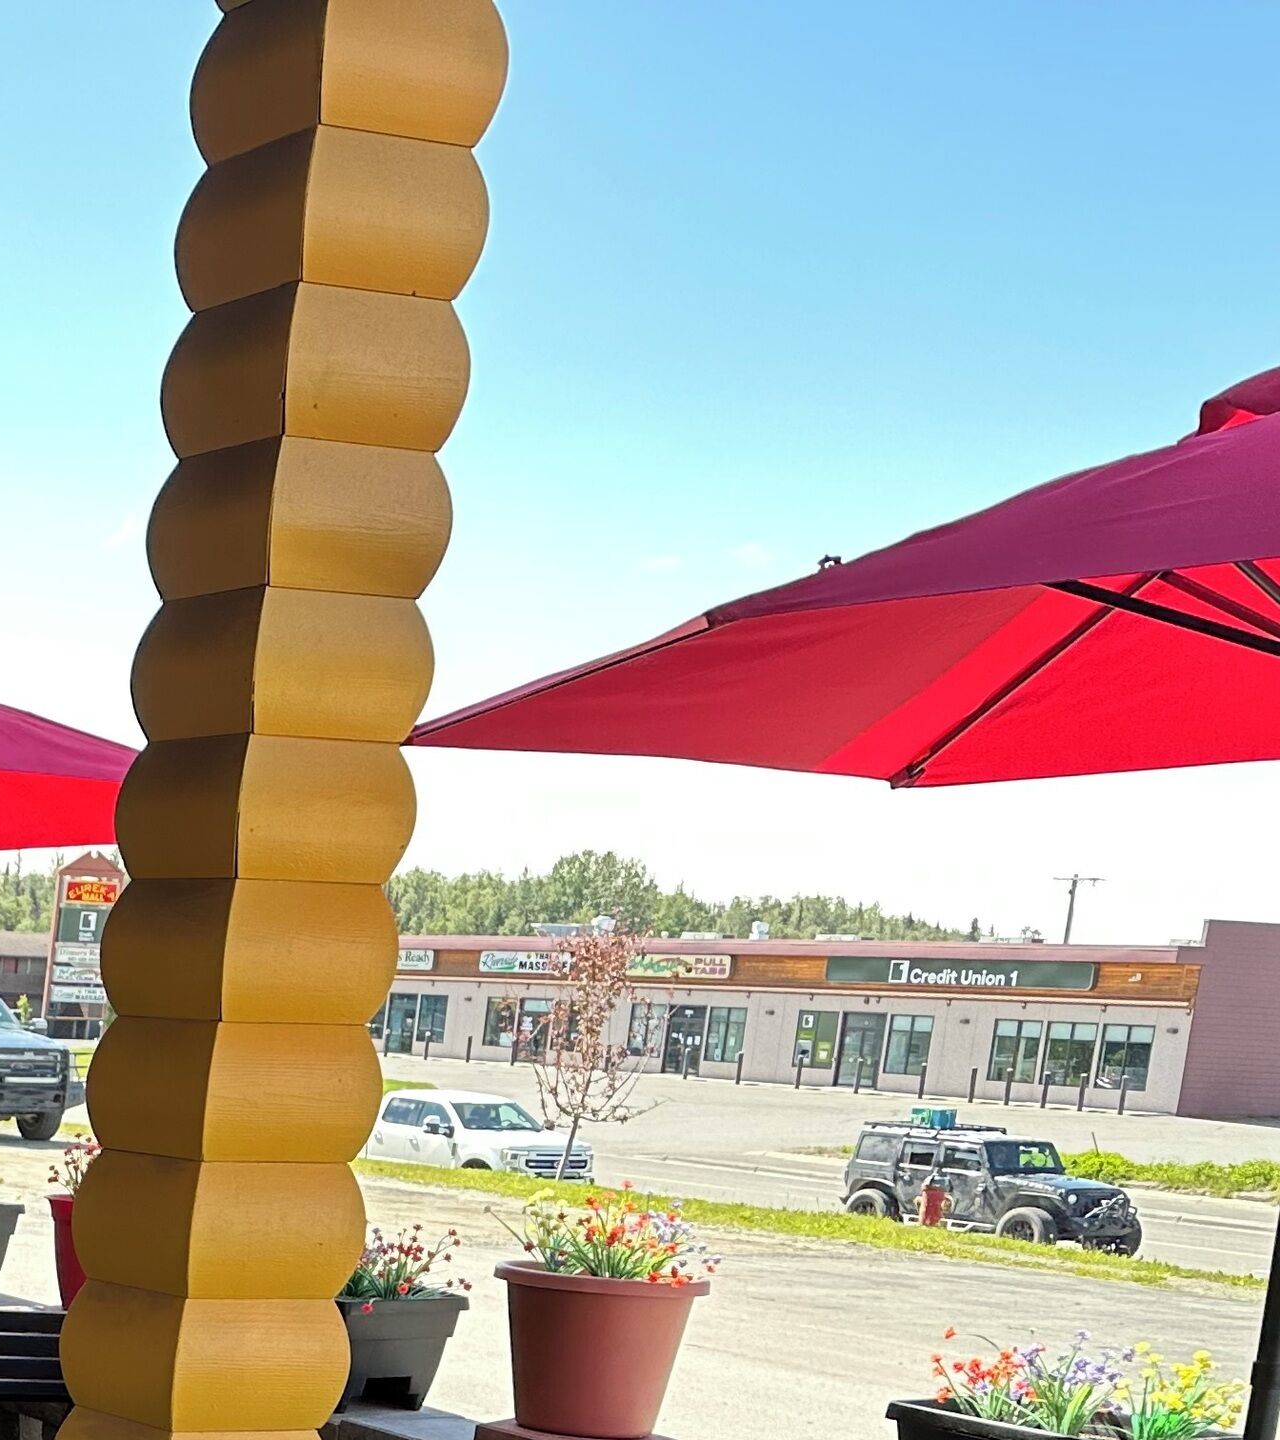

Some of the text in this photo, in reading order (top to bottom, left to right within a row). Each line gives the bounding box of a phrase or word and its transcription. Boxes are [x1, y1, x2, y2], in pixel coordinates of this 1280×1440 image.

[81, 892, 105, 902] MALL
[405, 950, 431, 966] Ready
[694, 957, 727, 967] PULL
[909, 967, 958, 985] Credit
[960, 969, 1007, 987] Union
[1010, 970, 1019, 987] 1
